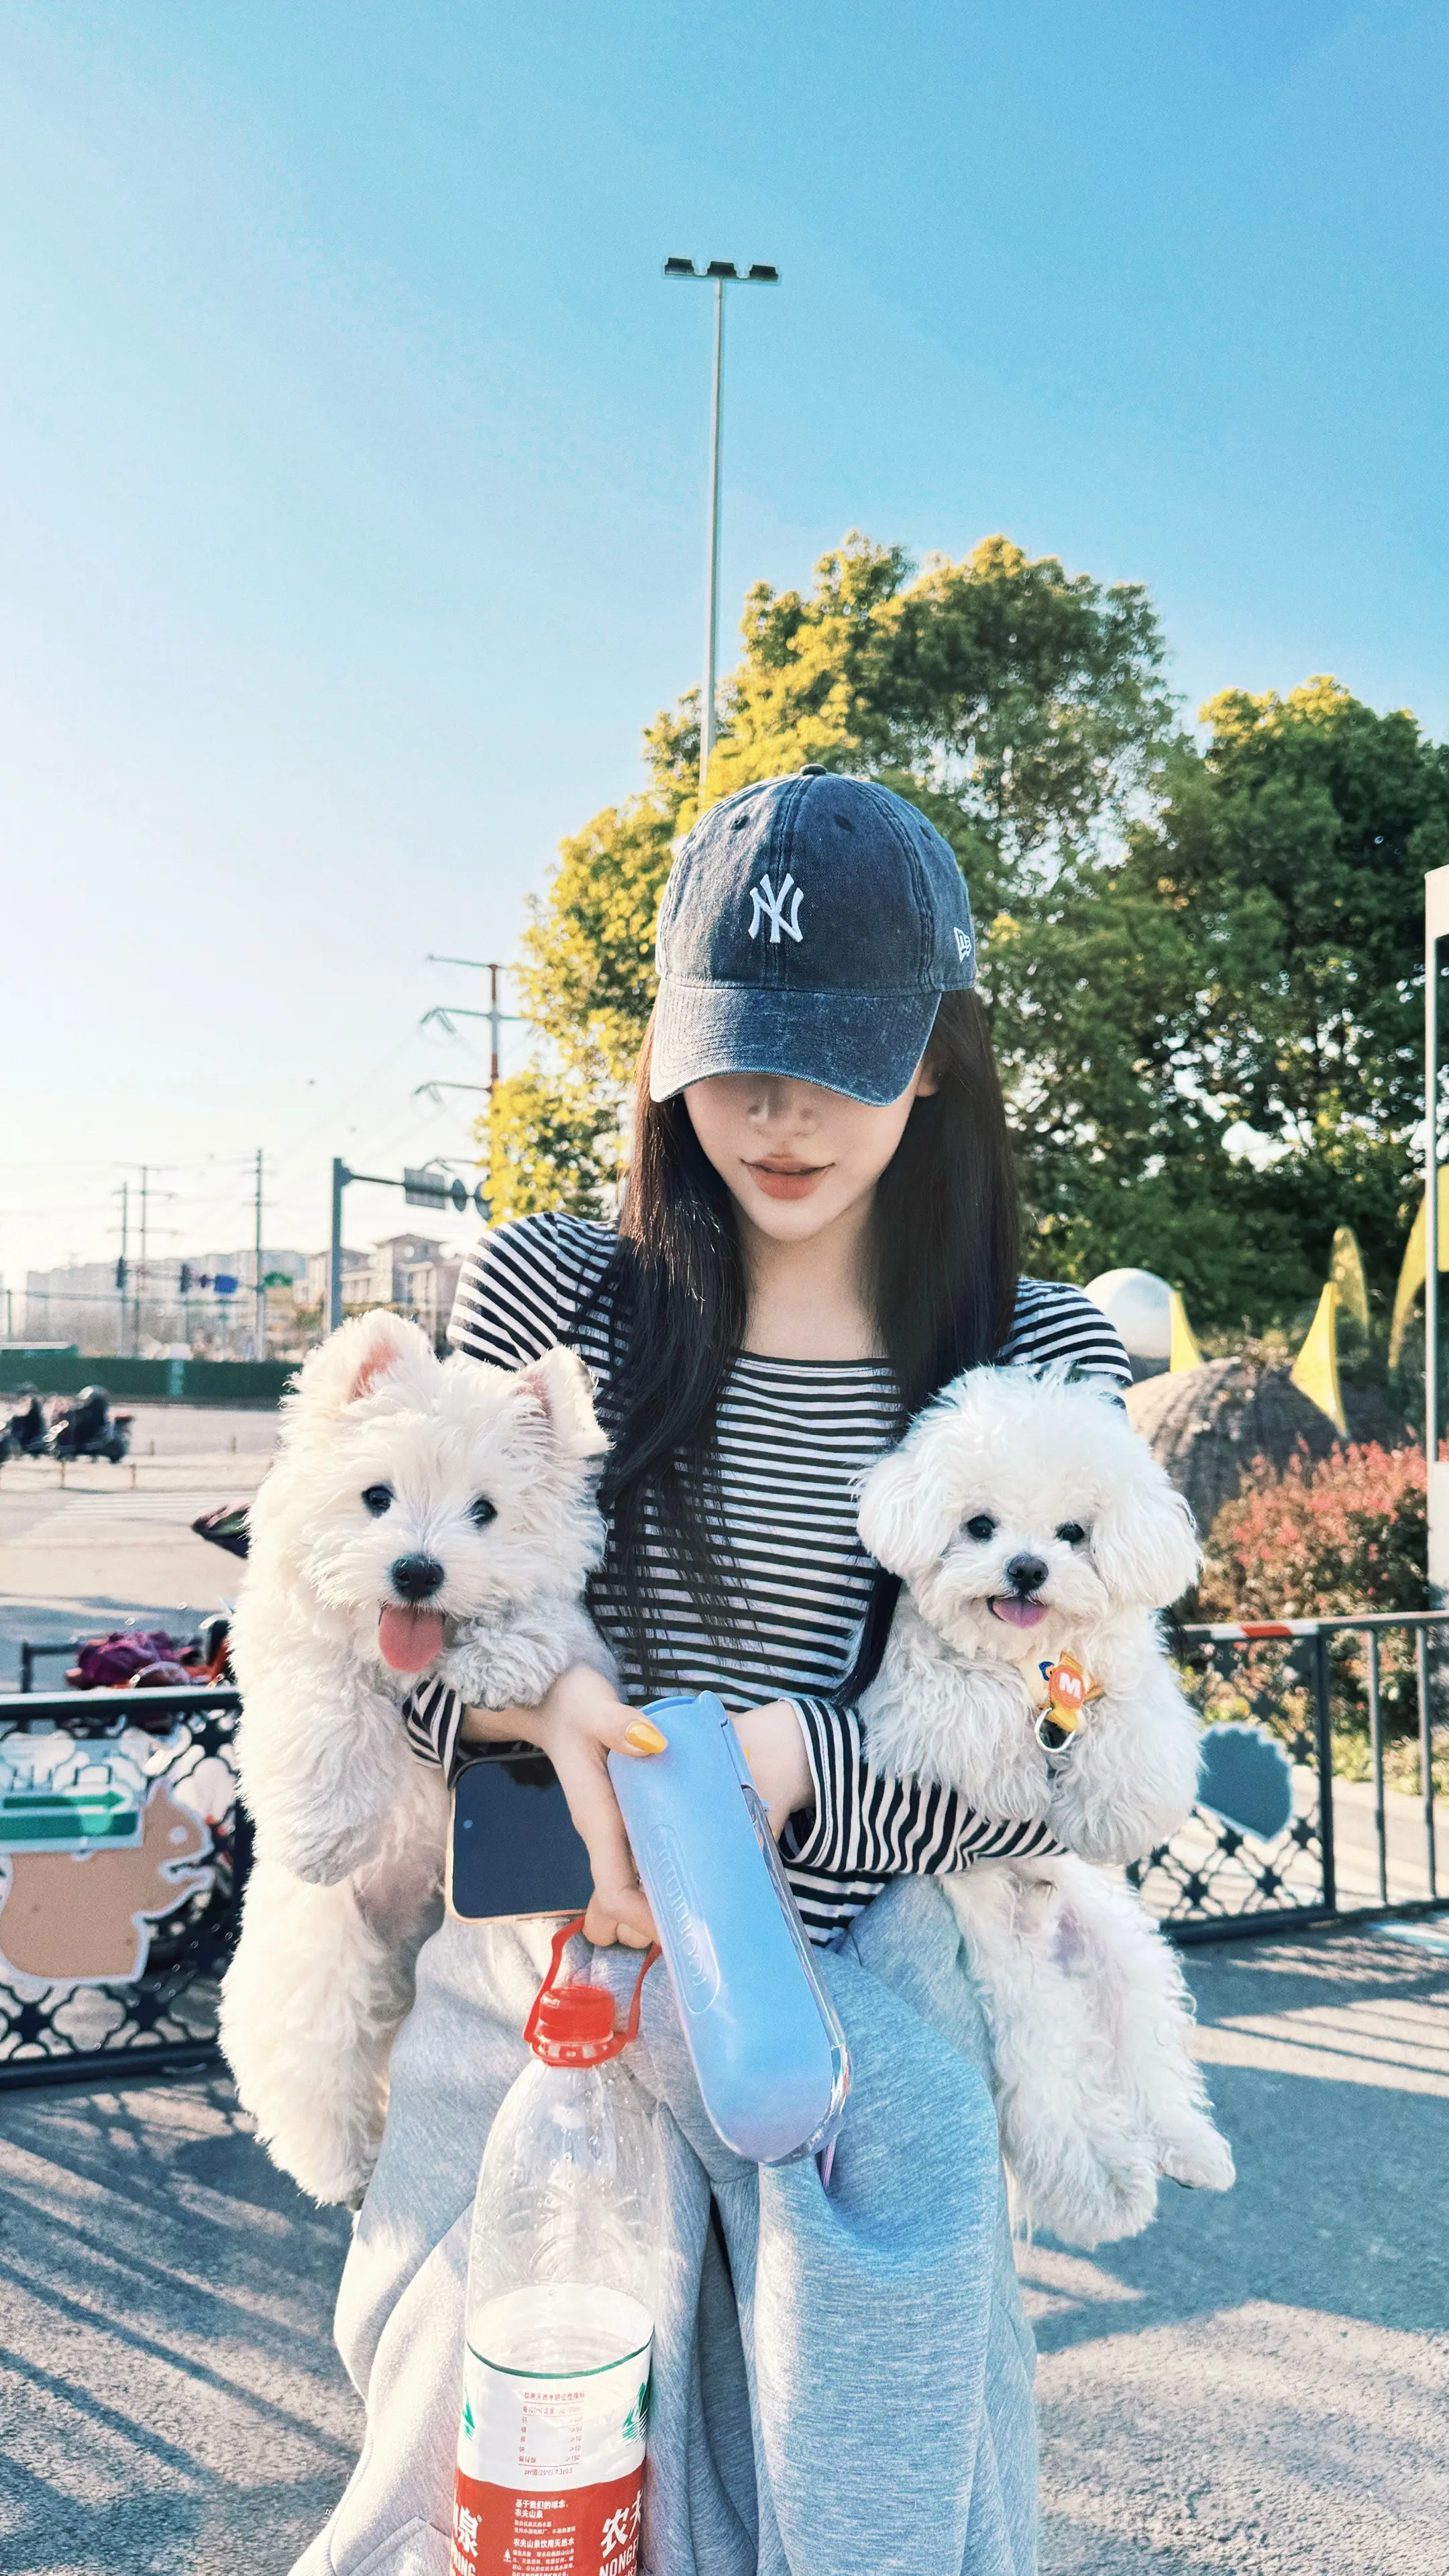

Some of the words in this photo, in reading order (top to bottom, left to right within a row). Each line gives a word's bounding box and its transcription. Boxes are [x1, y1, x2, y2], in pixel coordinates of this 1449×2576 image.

[748, 873, 804, 943] NY
[1059, 1672, 1081, 1699] M
[515, 2508, 543, 2518] 农夫山泉
[513, 2537, 575, 2548] 农夫山泉饮用天然水
